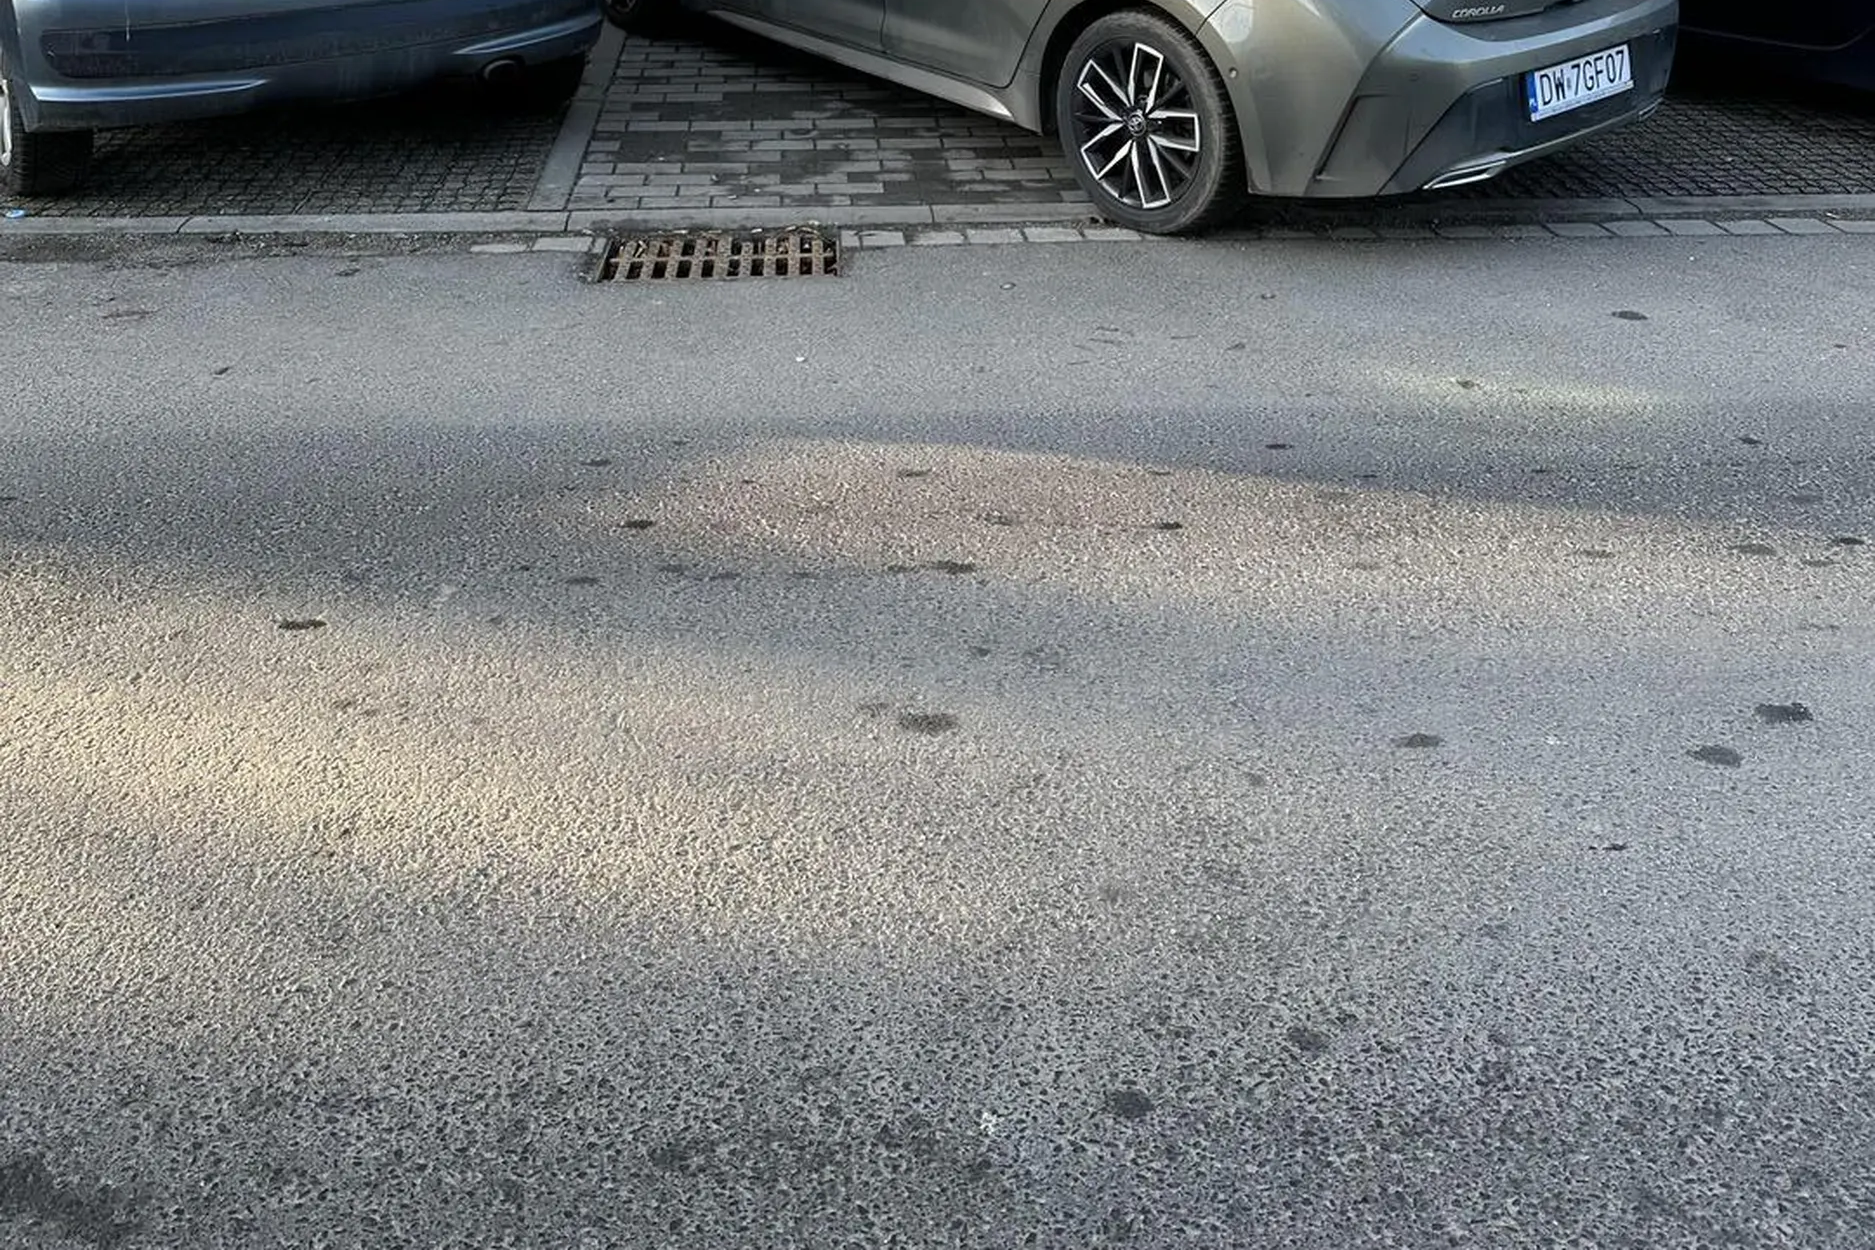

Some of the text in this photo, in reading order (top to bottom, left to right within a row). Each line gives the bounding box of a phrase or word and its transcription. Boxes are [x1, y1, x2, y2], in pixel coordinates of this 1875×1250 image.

[1452, 4, 1505, 18] COROLLA
[1540, 68, 1566, 106] DW
[1571, 50, 1624, 97] 7GF07
